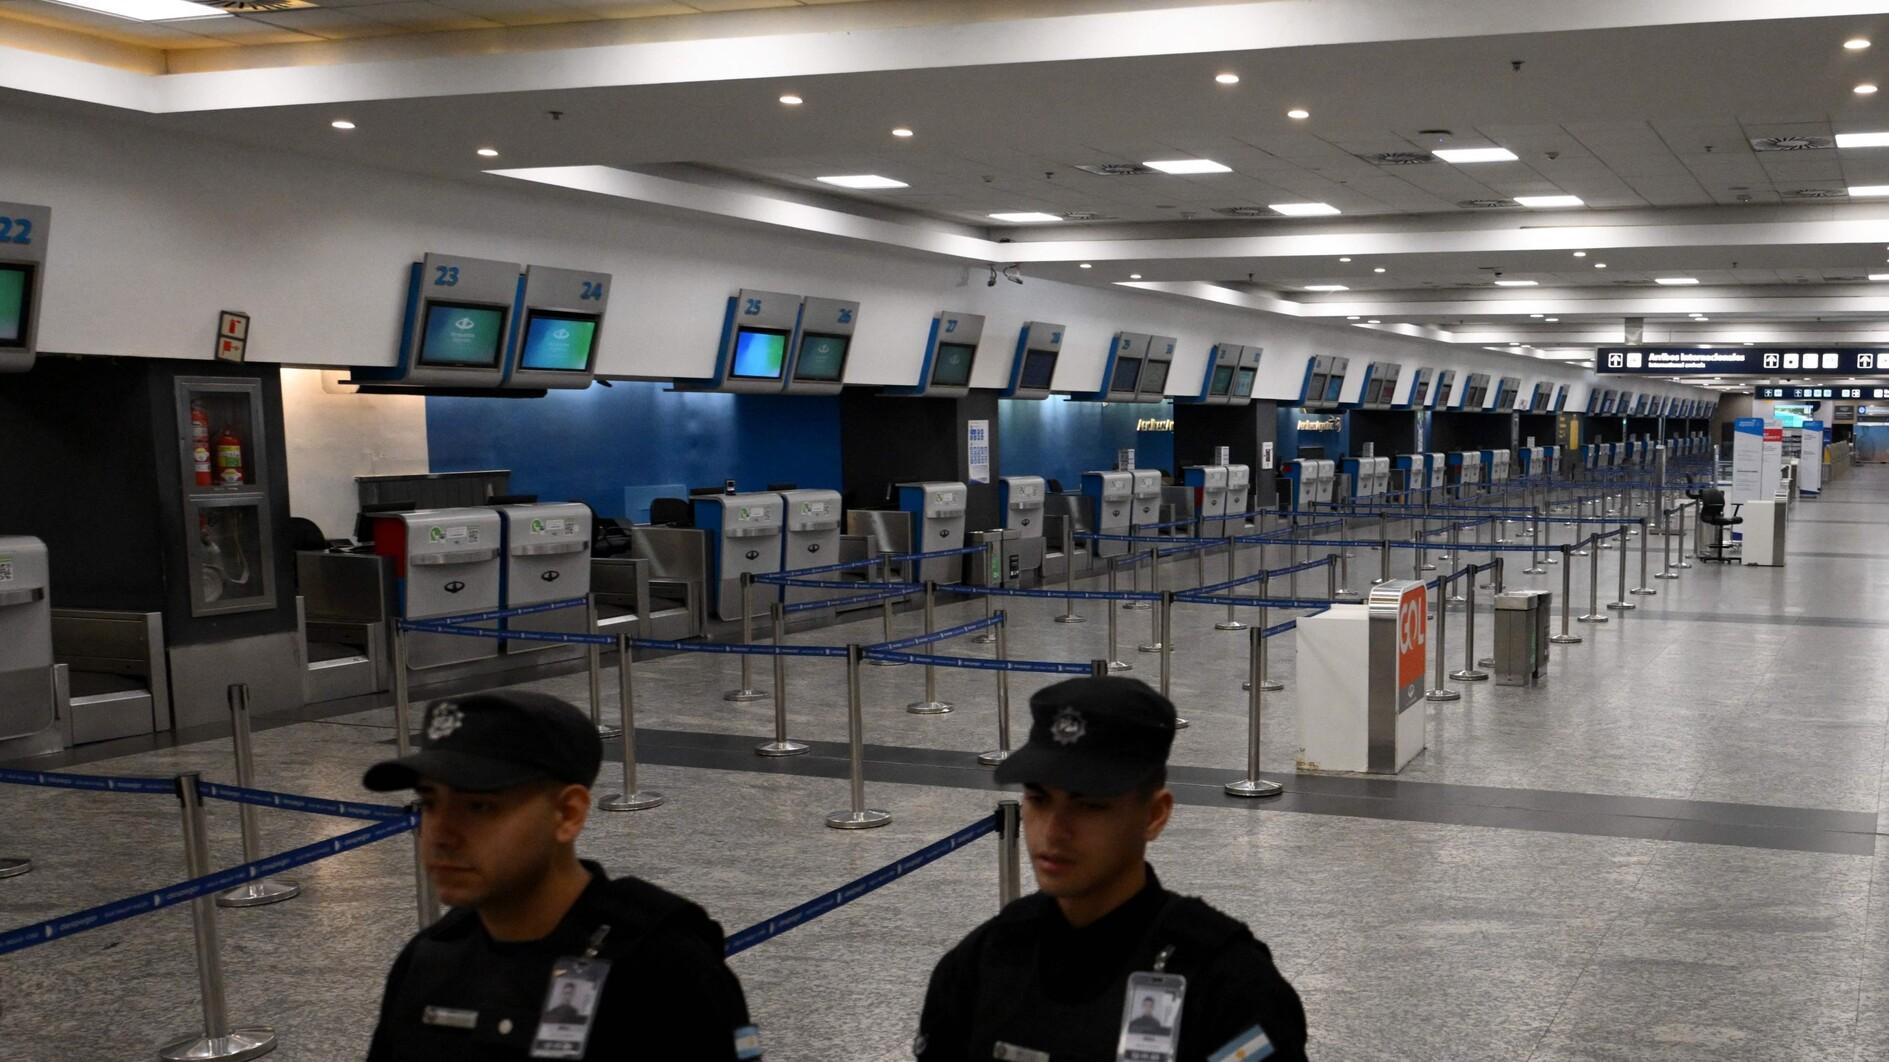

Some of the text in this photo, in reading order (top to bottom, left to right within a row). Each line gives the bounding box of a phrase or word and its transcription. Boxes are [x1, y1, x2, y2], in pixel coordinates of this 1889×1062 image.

[0, 216, 32, 245] 22
[434, 265, 460, 287] 23
[580, 281, 602, 300] 24
[744, 298, 761, 315] 25
[1400, 597, 1425, 654] GOL
